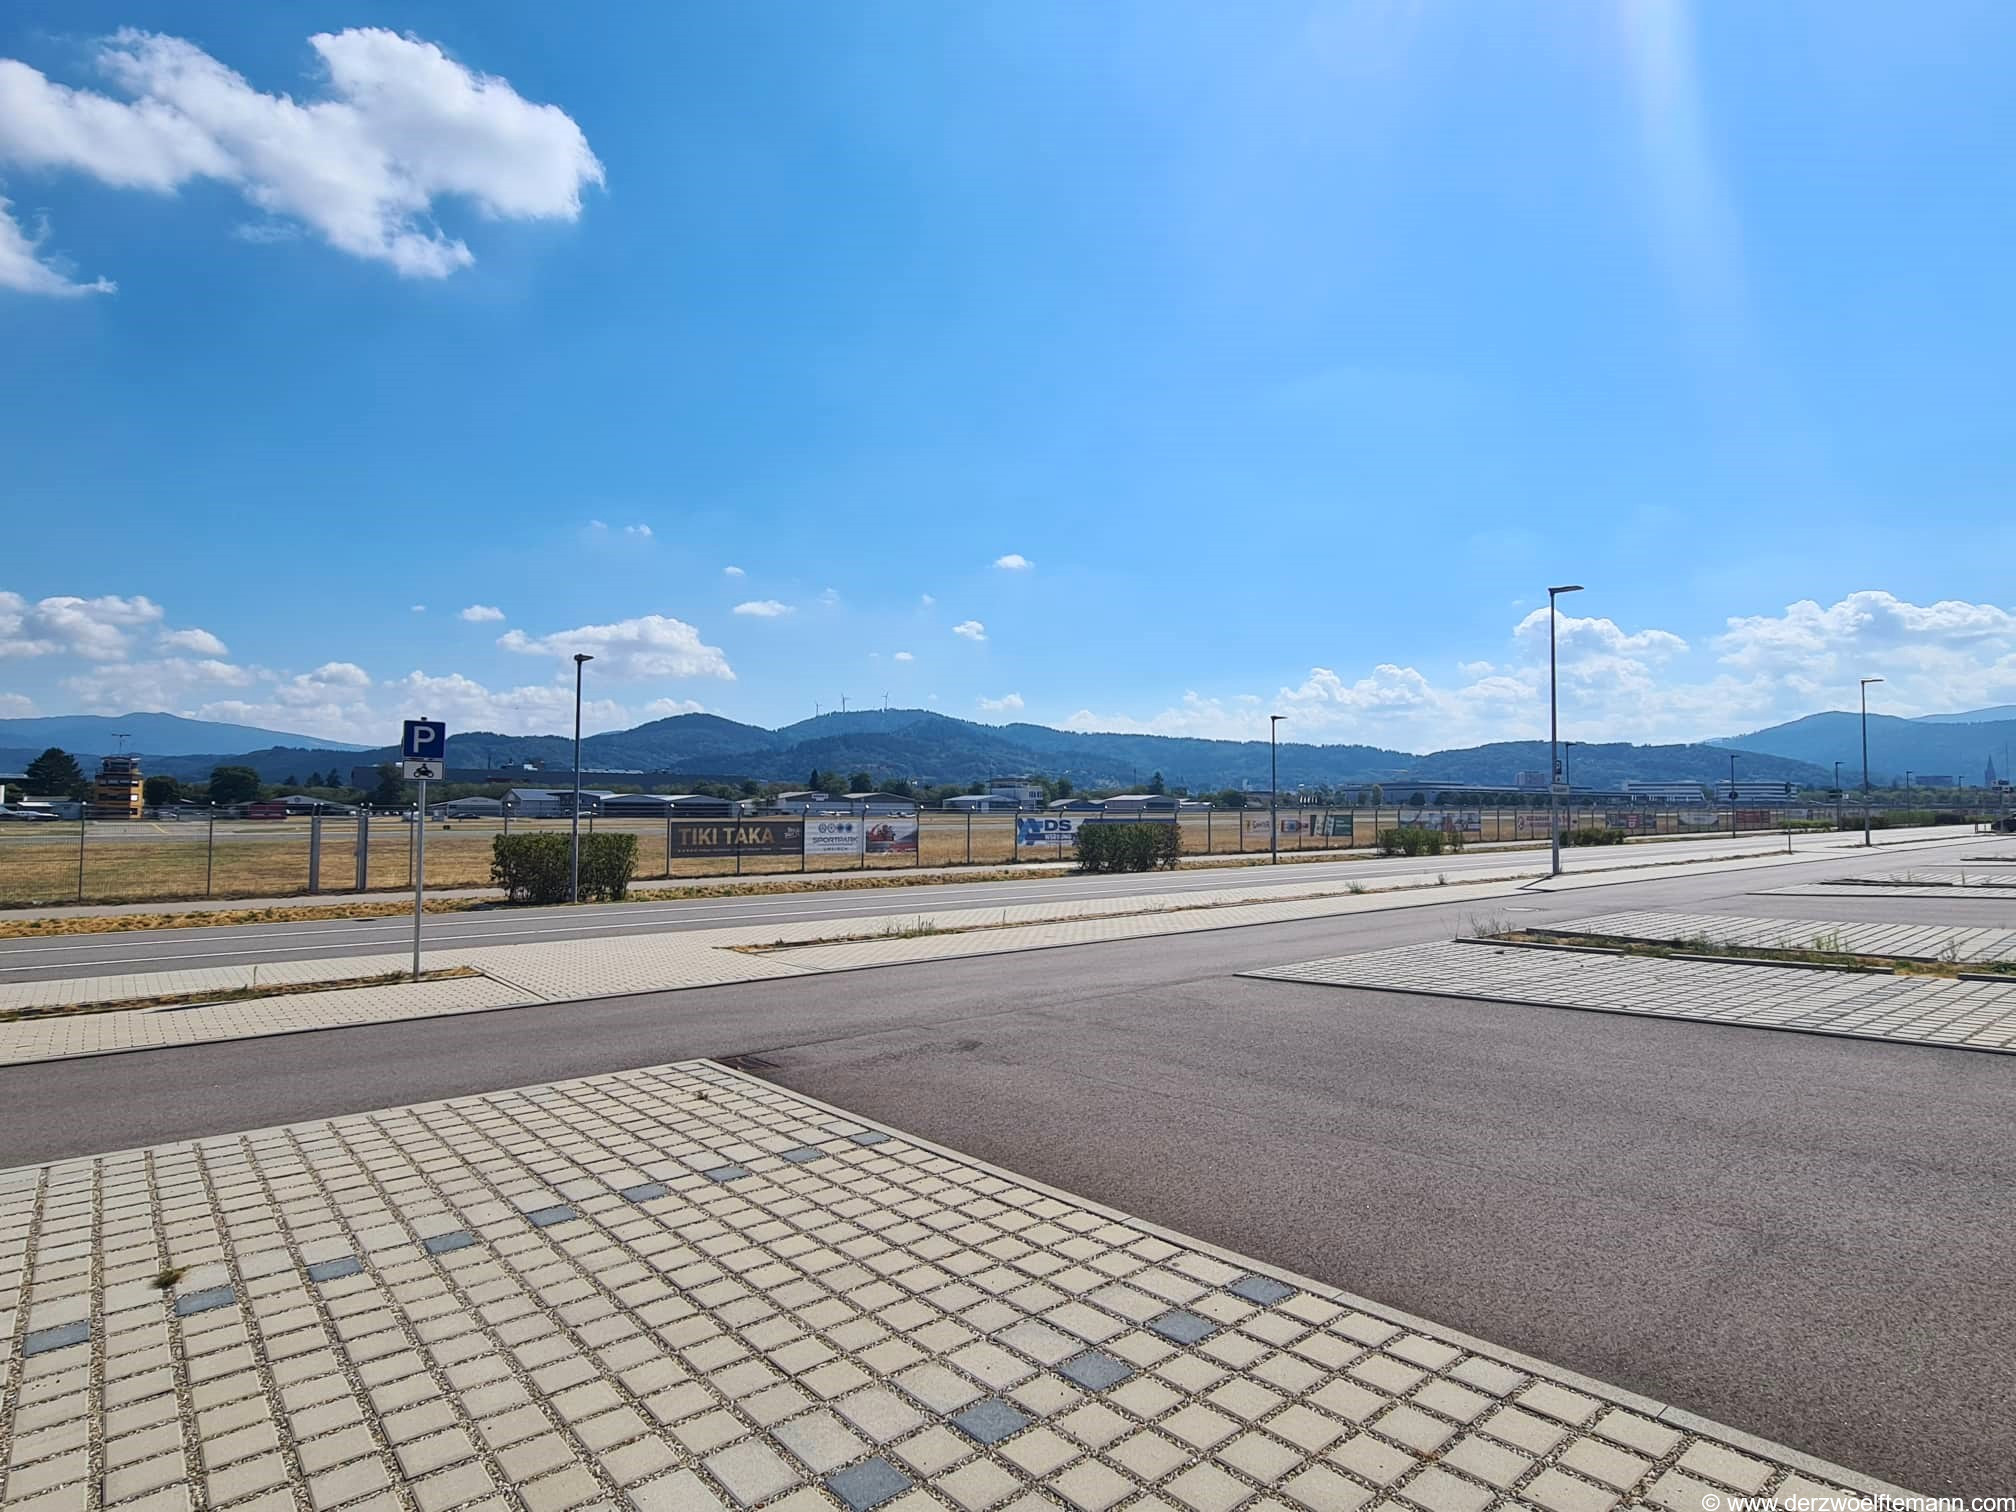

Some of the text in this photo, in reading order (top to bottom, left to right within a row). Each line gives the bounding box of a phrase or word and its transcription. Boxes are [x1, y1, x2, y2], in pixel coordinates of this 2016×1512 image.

[413, 726, 435, 753] P
[1044, 819, 1072, 831] DS
[678, 827, 718, 846] TIKI
[723, 826, 775, 845] TAKA
[813, 836, 858, 844] SPORTPARK
